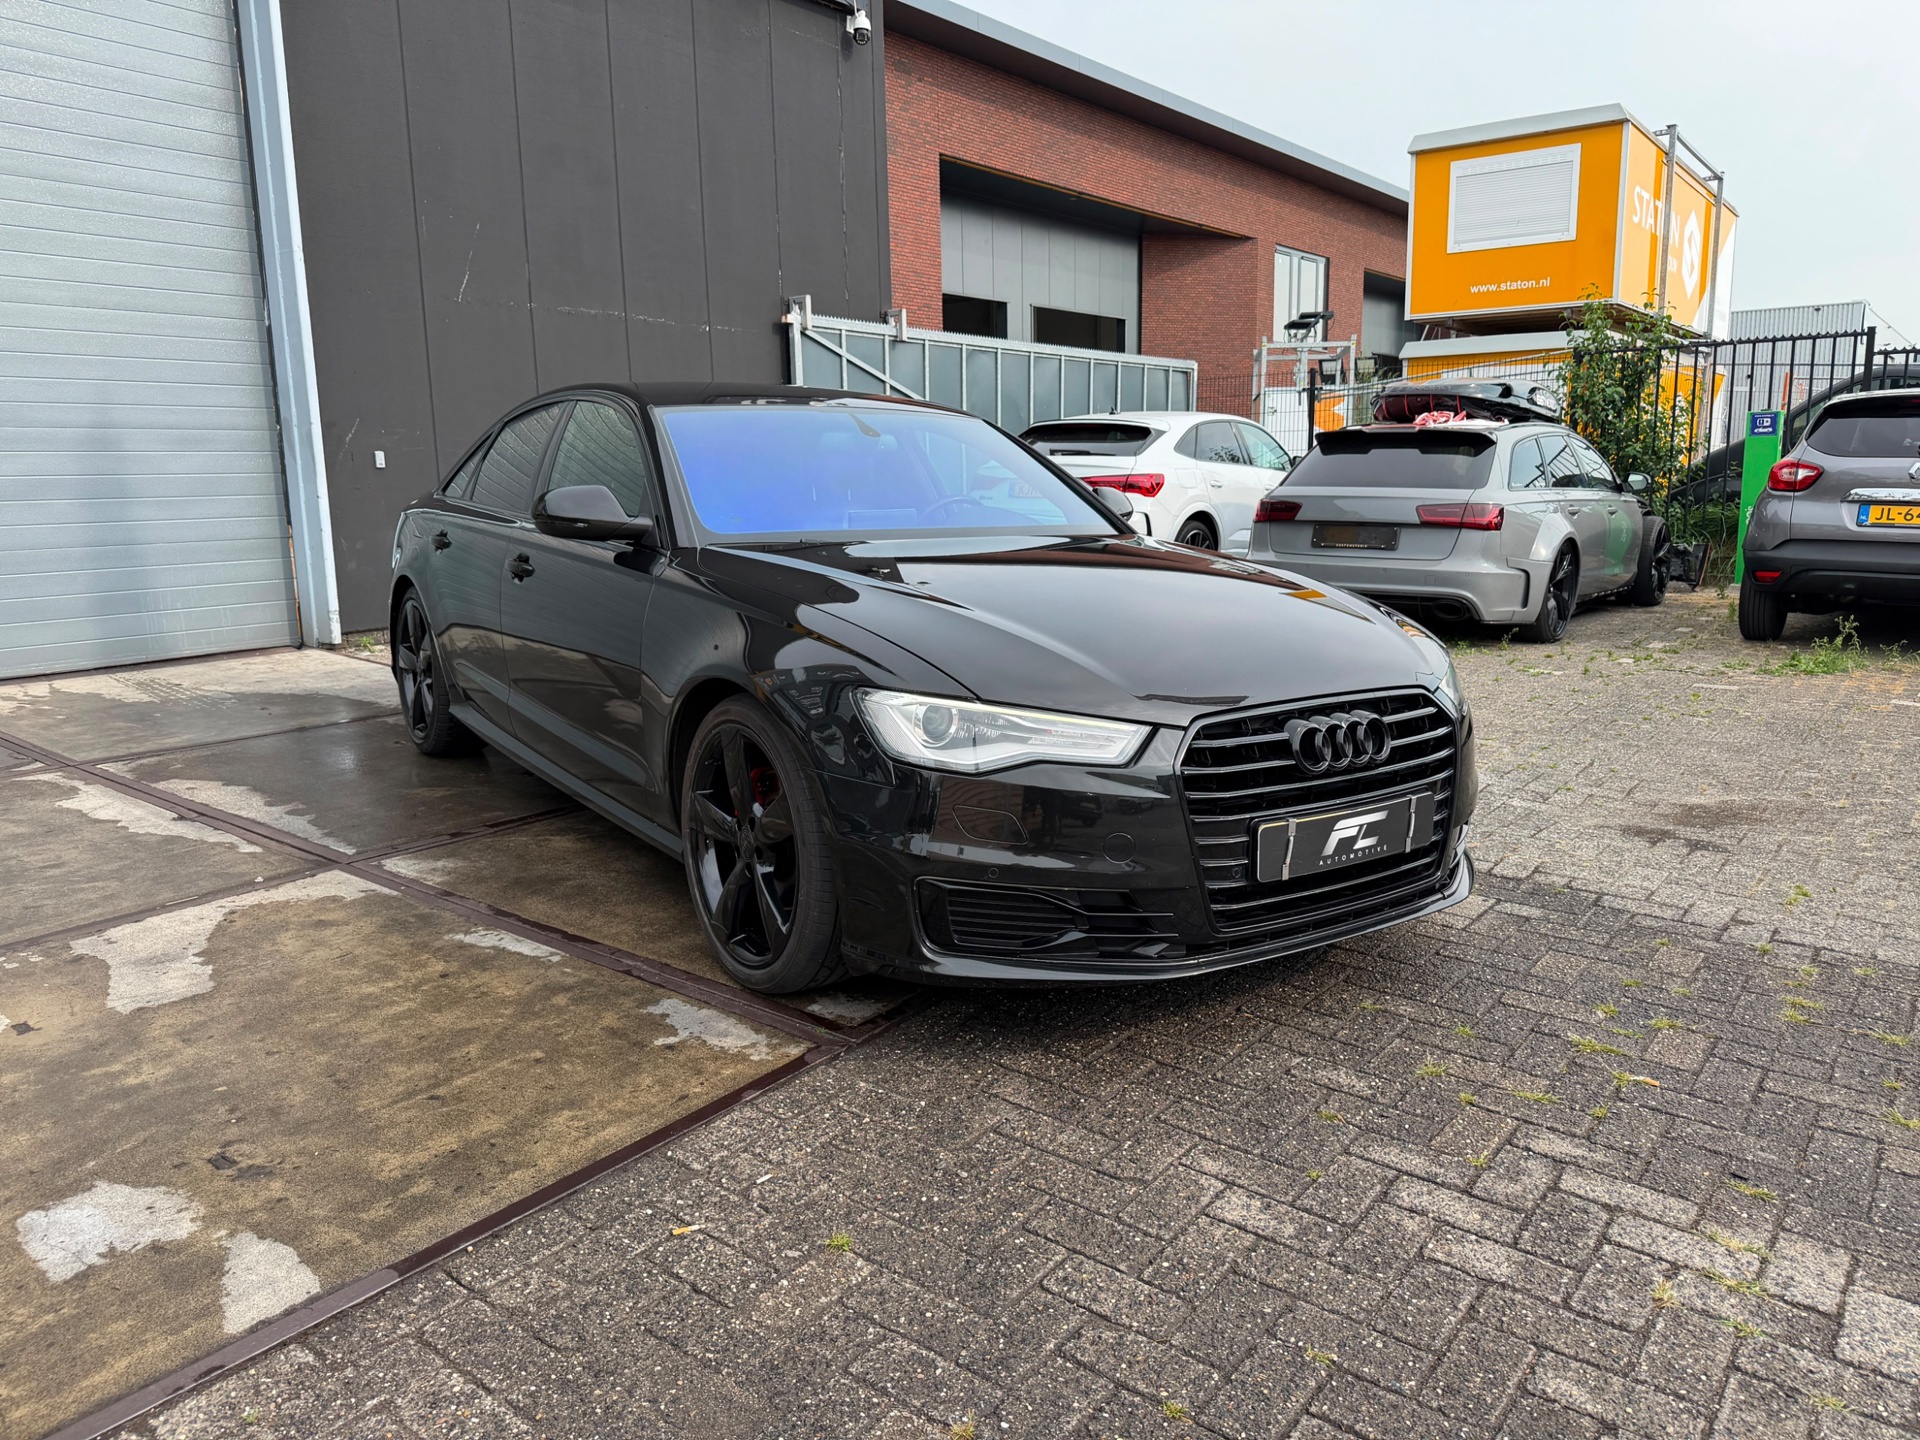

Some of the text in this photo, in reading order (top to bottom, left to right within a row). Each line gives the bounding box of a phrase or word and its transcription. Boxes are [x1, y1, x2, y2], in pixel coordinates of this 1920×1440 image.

[1632, 185, 1680, 248] STATN
[1470, 276, 1551, 293] www.staton.nl
[1318, 844, 1388, 866] AUTOMOTIVE
